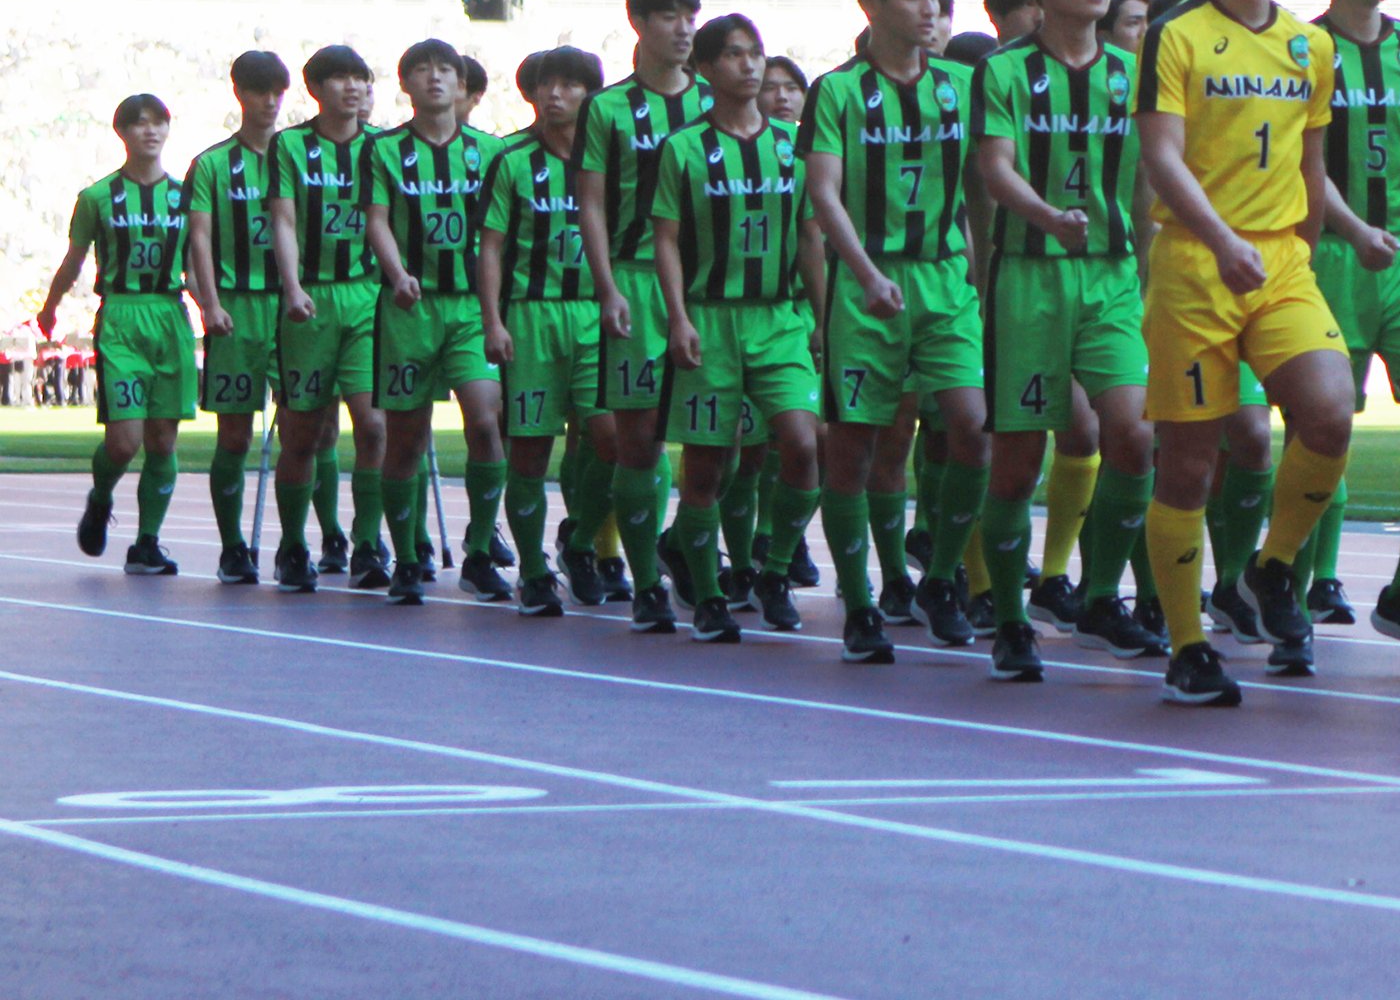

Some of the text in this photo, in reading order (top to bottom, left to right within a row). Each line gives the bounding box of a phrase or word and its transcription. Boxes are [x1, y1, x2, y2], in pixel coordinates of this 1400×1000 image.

[1205, 75, 1313, 101] MINAMI
[860, 121, 964, 145] MINAMI
[1023, 113, 1132, 137] MINAMI
[1254, 120, 1271, 171] 1
[1365, 129, 1388, 172] 5
[302, 171, 354, 187] MIN
[899, 165, 925, 206] 7
[1064, 156, 1090, 200] 4
[324, 203, 365, 235] 24
[529, 196, 580, 212] MIN
[109, 213, 185, 229] MINAMI
[251, 215, 272, 246] 2
[426, 211, 465, 245] 20
[739, 214, 770, 254] 11
[130, 240, 164, 270] 30
[554, 228, 584, 265] 17
[114, 378, 145, 410] 30
[215, 373, 252, 404] 29
[289, 370, 321, 399] 24
[386, 363, 419, 396] 20
[616, 359, 656, 397] 14
[843, 368, 867, 409] 7
[1019, 372, 1048, 416] 4
[1184, 361, 1206, 407] 1
[515, 390, 546, 426] 17
[685, 394, 718, 433] 11
[57, 784, 548, 808] 8
